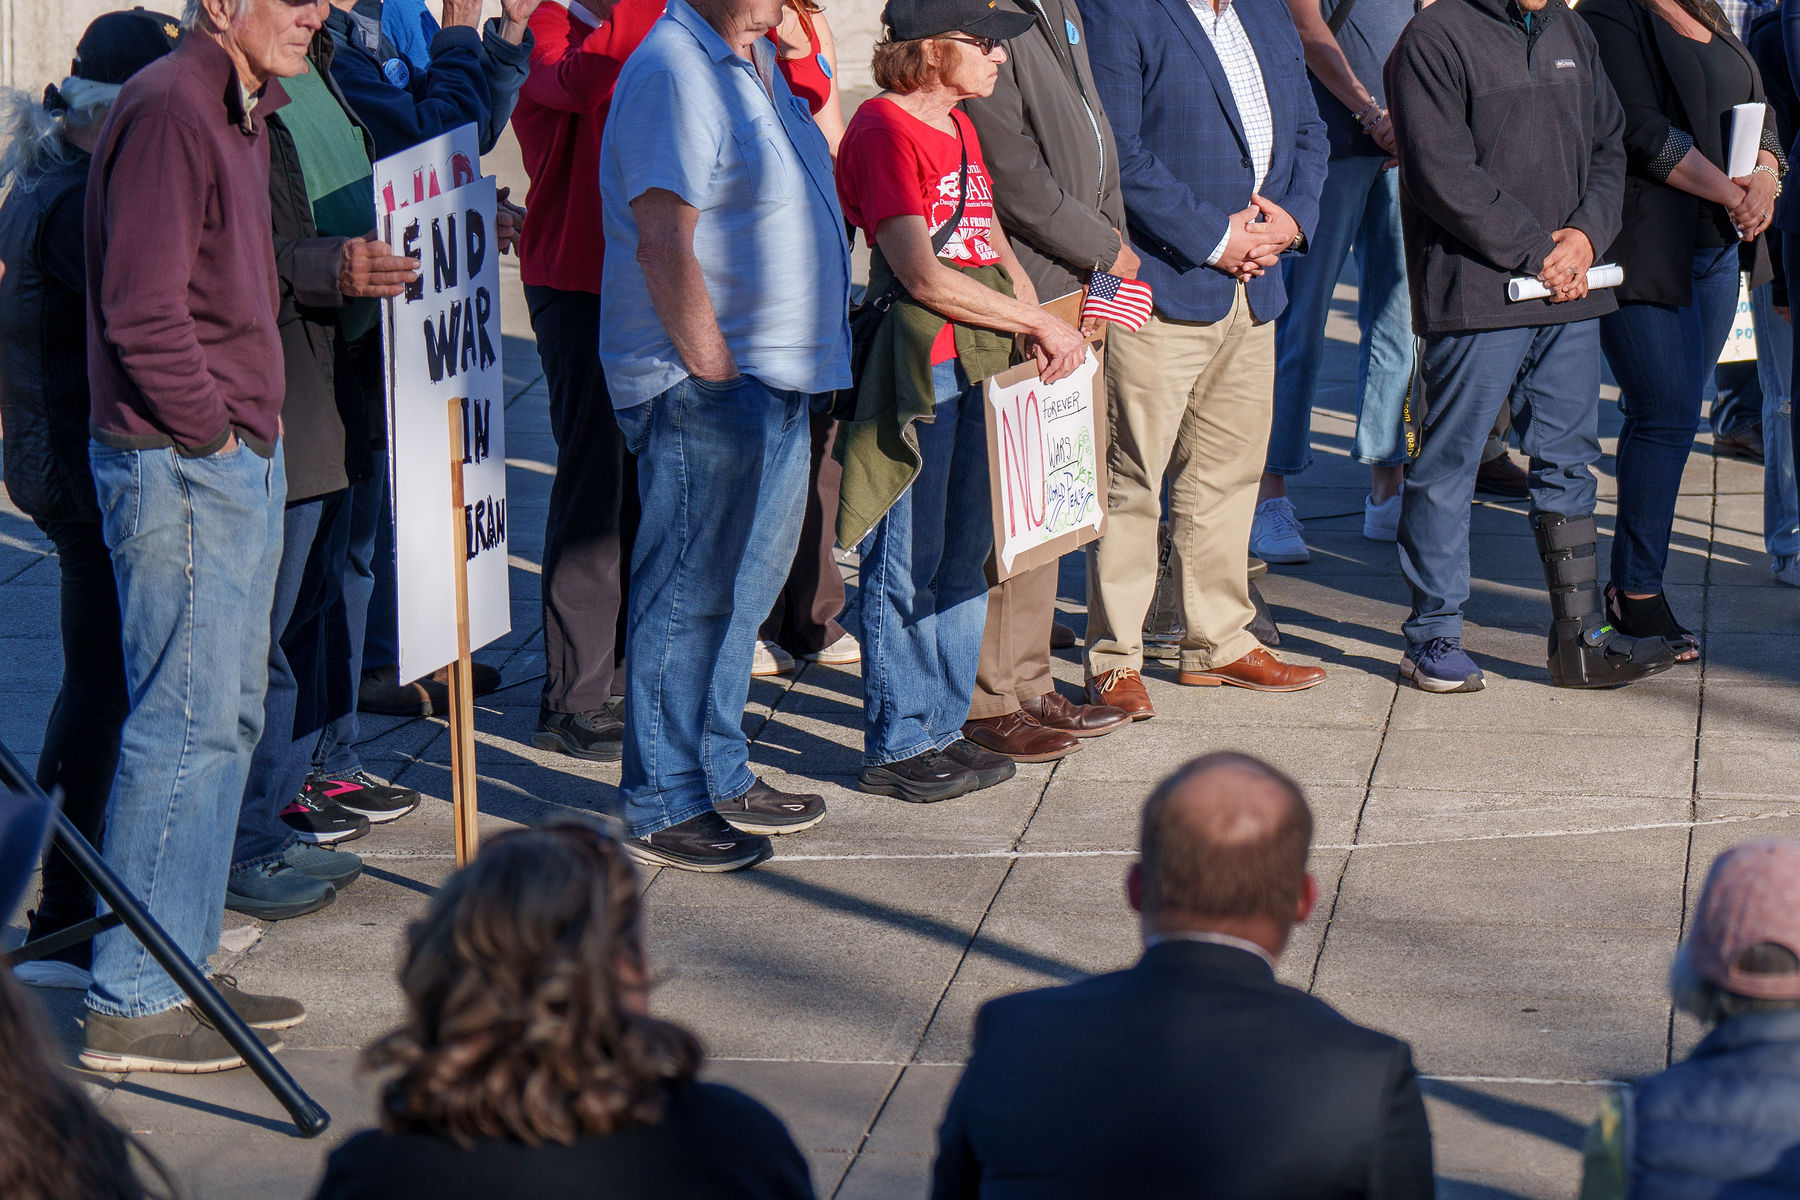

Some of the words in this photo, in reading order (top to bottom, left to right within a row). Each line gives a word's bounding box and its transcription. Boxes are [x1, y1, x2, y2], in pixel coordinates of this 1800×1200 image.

[403, 207, 486, 305] END
[423, 285, 497, 385] WAR
[460, 396, 491, 466] IN
[1001, 388, 1046, 539] NO
[1041, 390, 1080, 419] FOREVER
[1046, 433, 1073, 469] WARS
[464, 493, 506, 563] IRAN
